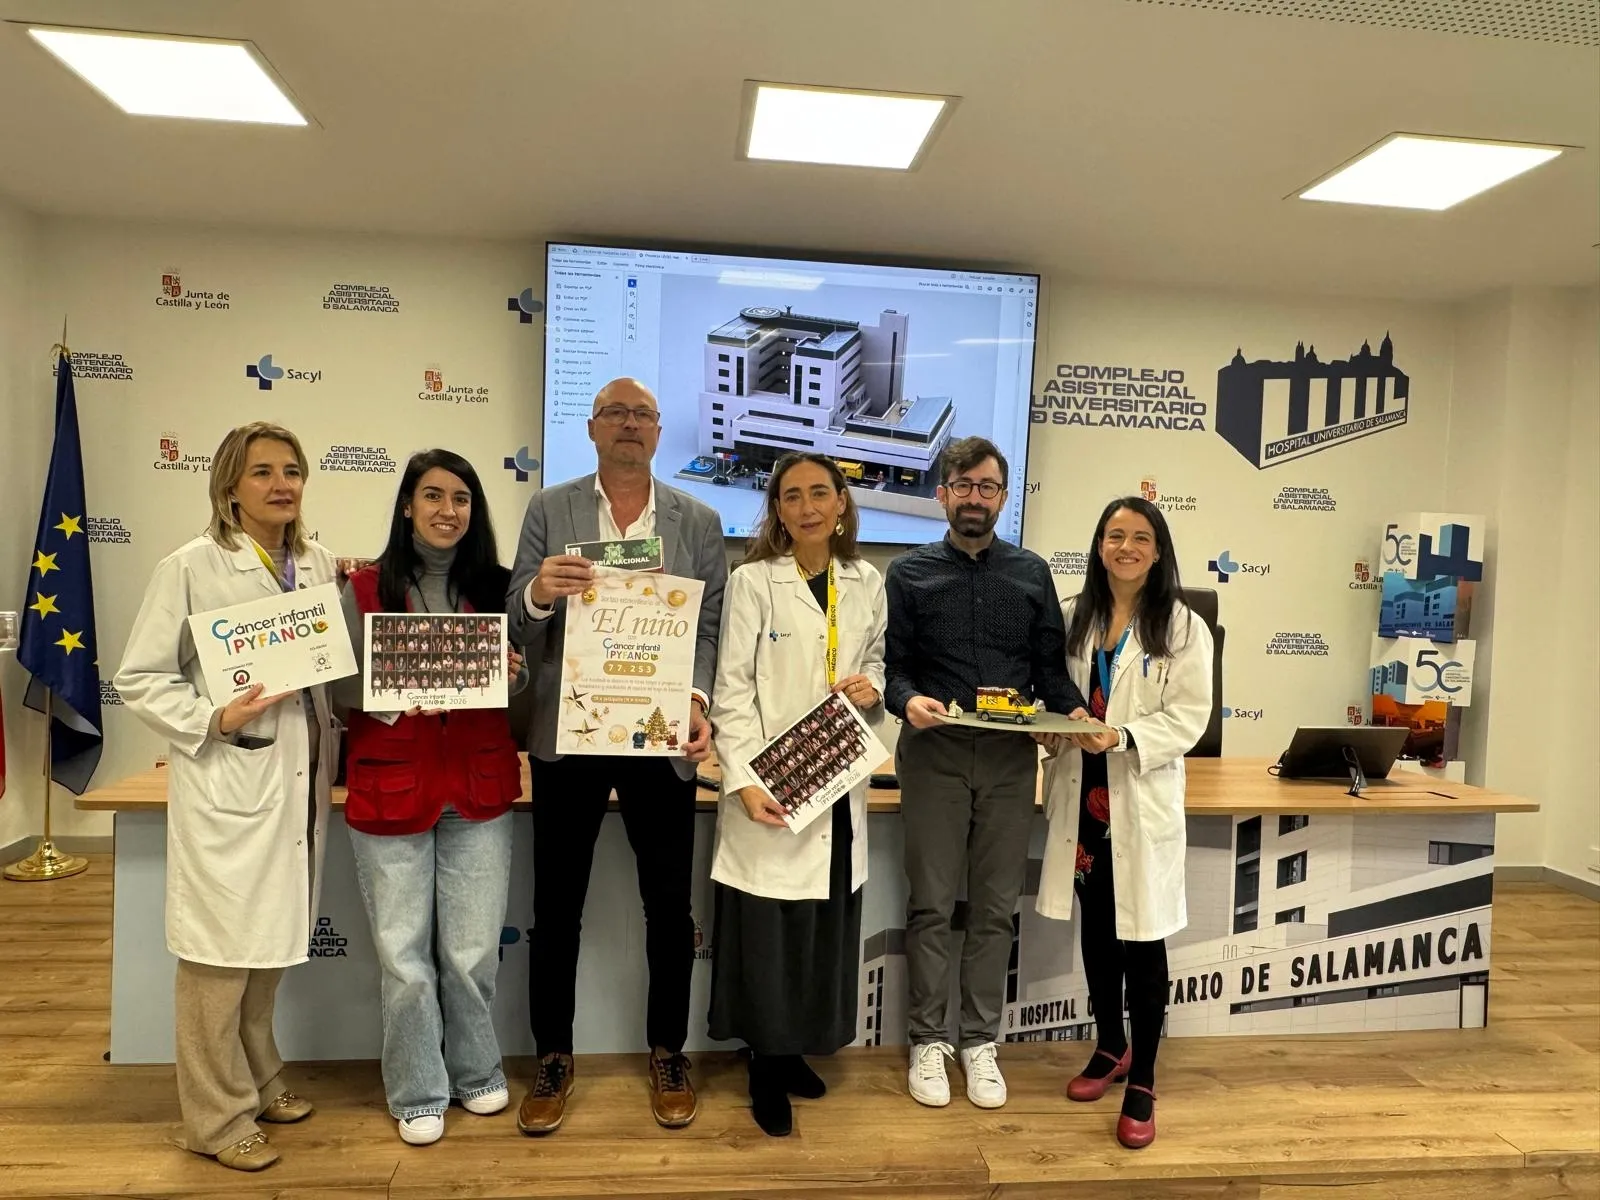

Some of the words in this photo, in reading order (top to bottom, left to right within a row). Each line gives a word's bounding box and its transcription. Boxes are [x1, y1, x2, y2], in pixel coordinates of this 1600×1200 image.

[333, 284, 390, 293] COMPLEJO
[185, 290, 213, 300] Junta
[217, 291, 230, 300] de
[328, 290, 395, 299] ASISTENCIAL
[155, 297, 192, 308] Castilla
[194, 301, 202, 310] y
[205, 299, 230, 310] León
[322, 296, 400, 307] UNIVERSITARIO
[332, 304, 400, 313] SALAMANCA
[71, 352, 123, 361] OMPLEJO
[69, 359, 128, 367] SISTENCIAL
[72, 372, 133, 380] ALAMANCA
[286, 368, 322, 383] Sacyl
[1056, 364, 1185, 384] COMPLEJO
[446, 384, 473, 394] Junta
[477, 386, 489, 395] de
[1043, 379, 1196, 400] ASISTENCIAL
[418, 392, 453, 402] Castilla
[455, 395, 463, 404] y
[464, 393, 489, 403] León
[1031, 394, 1207, 416] UNIVERSITARIO
[1052, 411, 1206, 431] SALAMANCA
[1267, 436, 1312, 457] HOSPITAL
[1313, 422, 1365, 443] UNIVERSITARIO
[1365, 419, 1374, 428] DE
[1375, 410, 1406, 425] SALAMANCA
[330, 445, 387, 454] COMPLEJO
[182, 454, 211, 463] Junta
[325, 452, 391, 461] ASISTENCIAL
[153, 460, 190, 471] Castilla
[193, 464, 200, 473] y
[319, 458, 397, 467] UNIVERSITARIO
[329, 465, 396, 474] SALAMANCA
[1282, 486, 1329, 494] COMPLEJO
[1159, 494, 1183, 503] Junta
[1185, 495, 1197, 503] de
[1277, 492, 1332, 500] ASISTENCIAL
[1167, 503, 1173, 511] y
[1175, 502, 1196, 511] León
[1273, 498, 1337, 506] UNIVERSITARIO
[1281, 504, 1336, 512] SALAMANCA
[613, 556, 650, 566] NACIONAL
[1241, 563, 1271, 575] Sacyl
[1348, 581, 1378, 590] Castilla
[211, 617, 277, 650] Cáncer
[278, 602, 326, 627] infantil
[591, 605, 634, 634] El
[632, 609, 689, 638] niño
[233, 623, 311, 654] PYFANO
[636, 643, 661, 654] infantil
[610, 650, 650, 660] PYFANO
[1234, 708, 1263, 721] Sacyl
[1020, 997, 1077, 1027] HOSPITAL
[1241, 962, 1270, 995] DE
[1290, 922, 1483, 988] SALAMANCA
